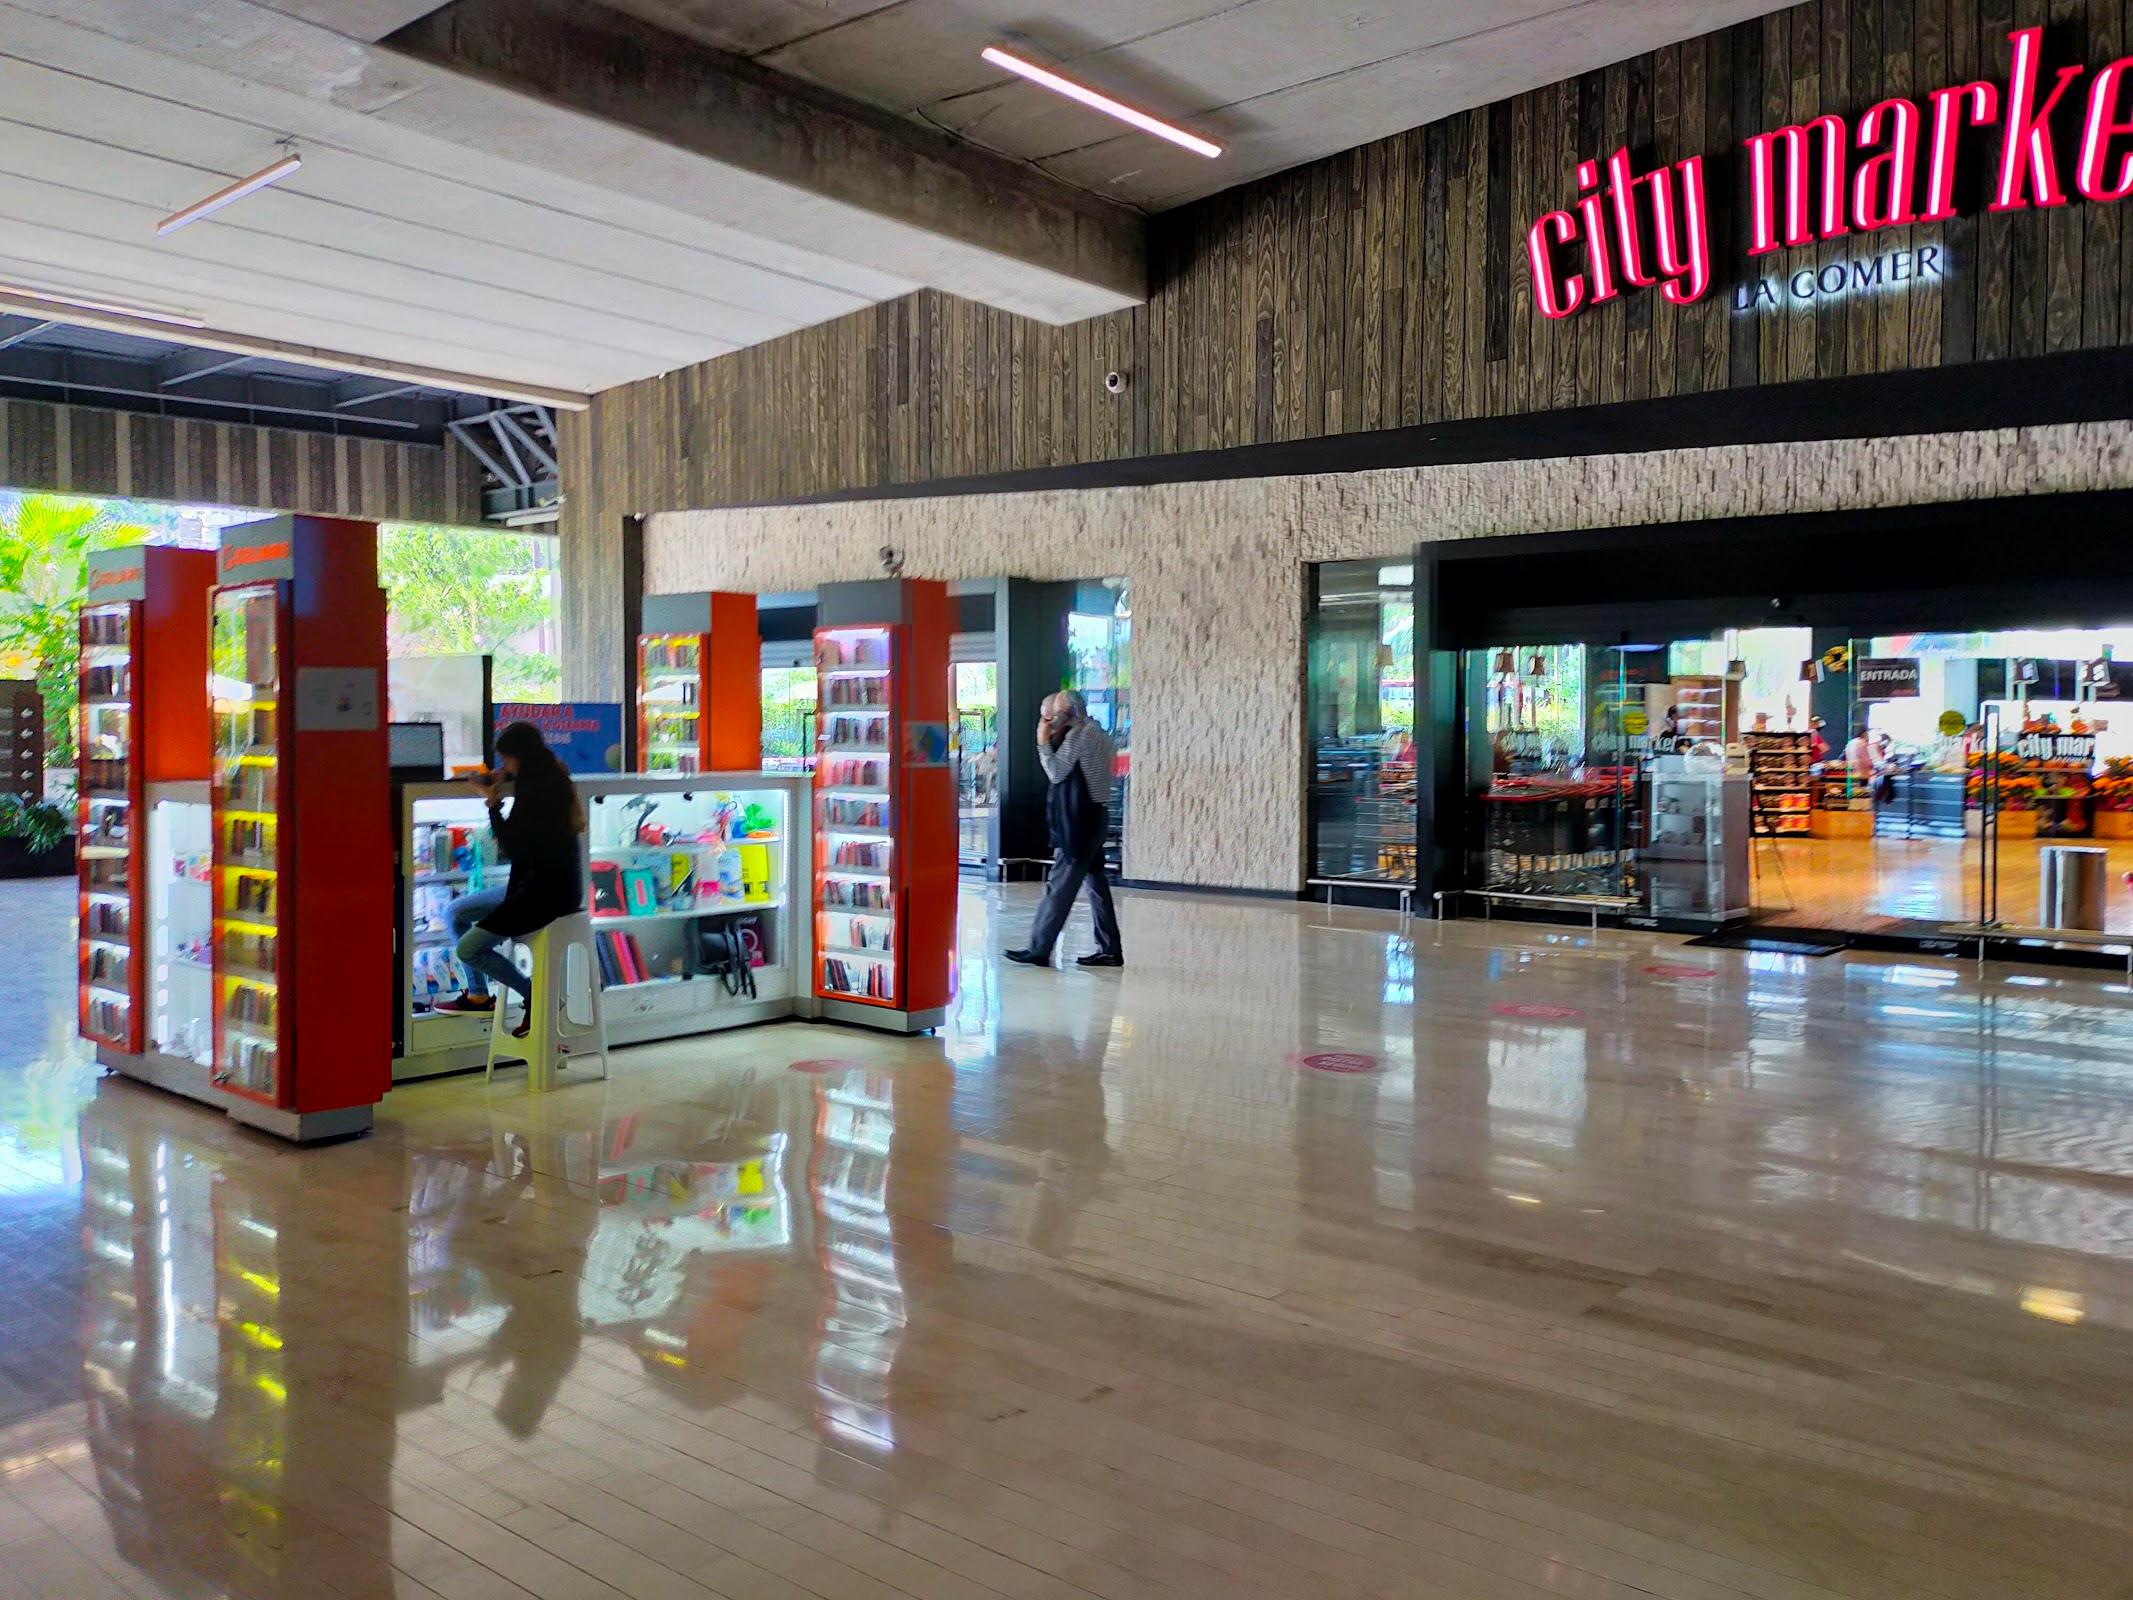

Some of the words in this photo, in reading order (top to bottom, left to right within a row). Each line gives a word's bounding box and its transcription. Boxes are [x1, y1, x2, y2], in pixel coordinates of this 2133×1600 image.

[1528, 146, 1711, 319] city
[1745, 26, 2133, 257] marke
[1733, 278, 1776, 311] LA
[1791, 246, 1943, 299] COMER
[1860, 668, 1919, 682] ENTRADA
[2018, 734, 2053, 760] city
